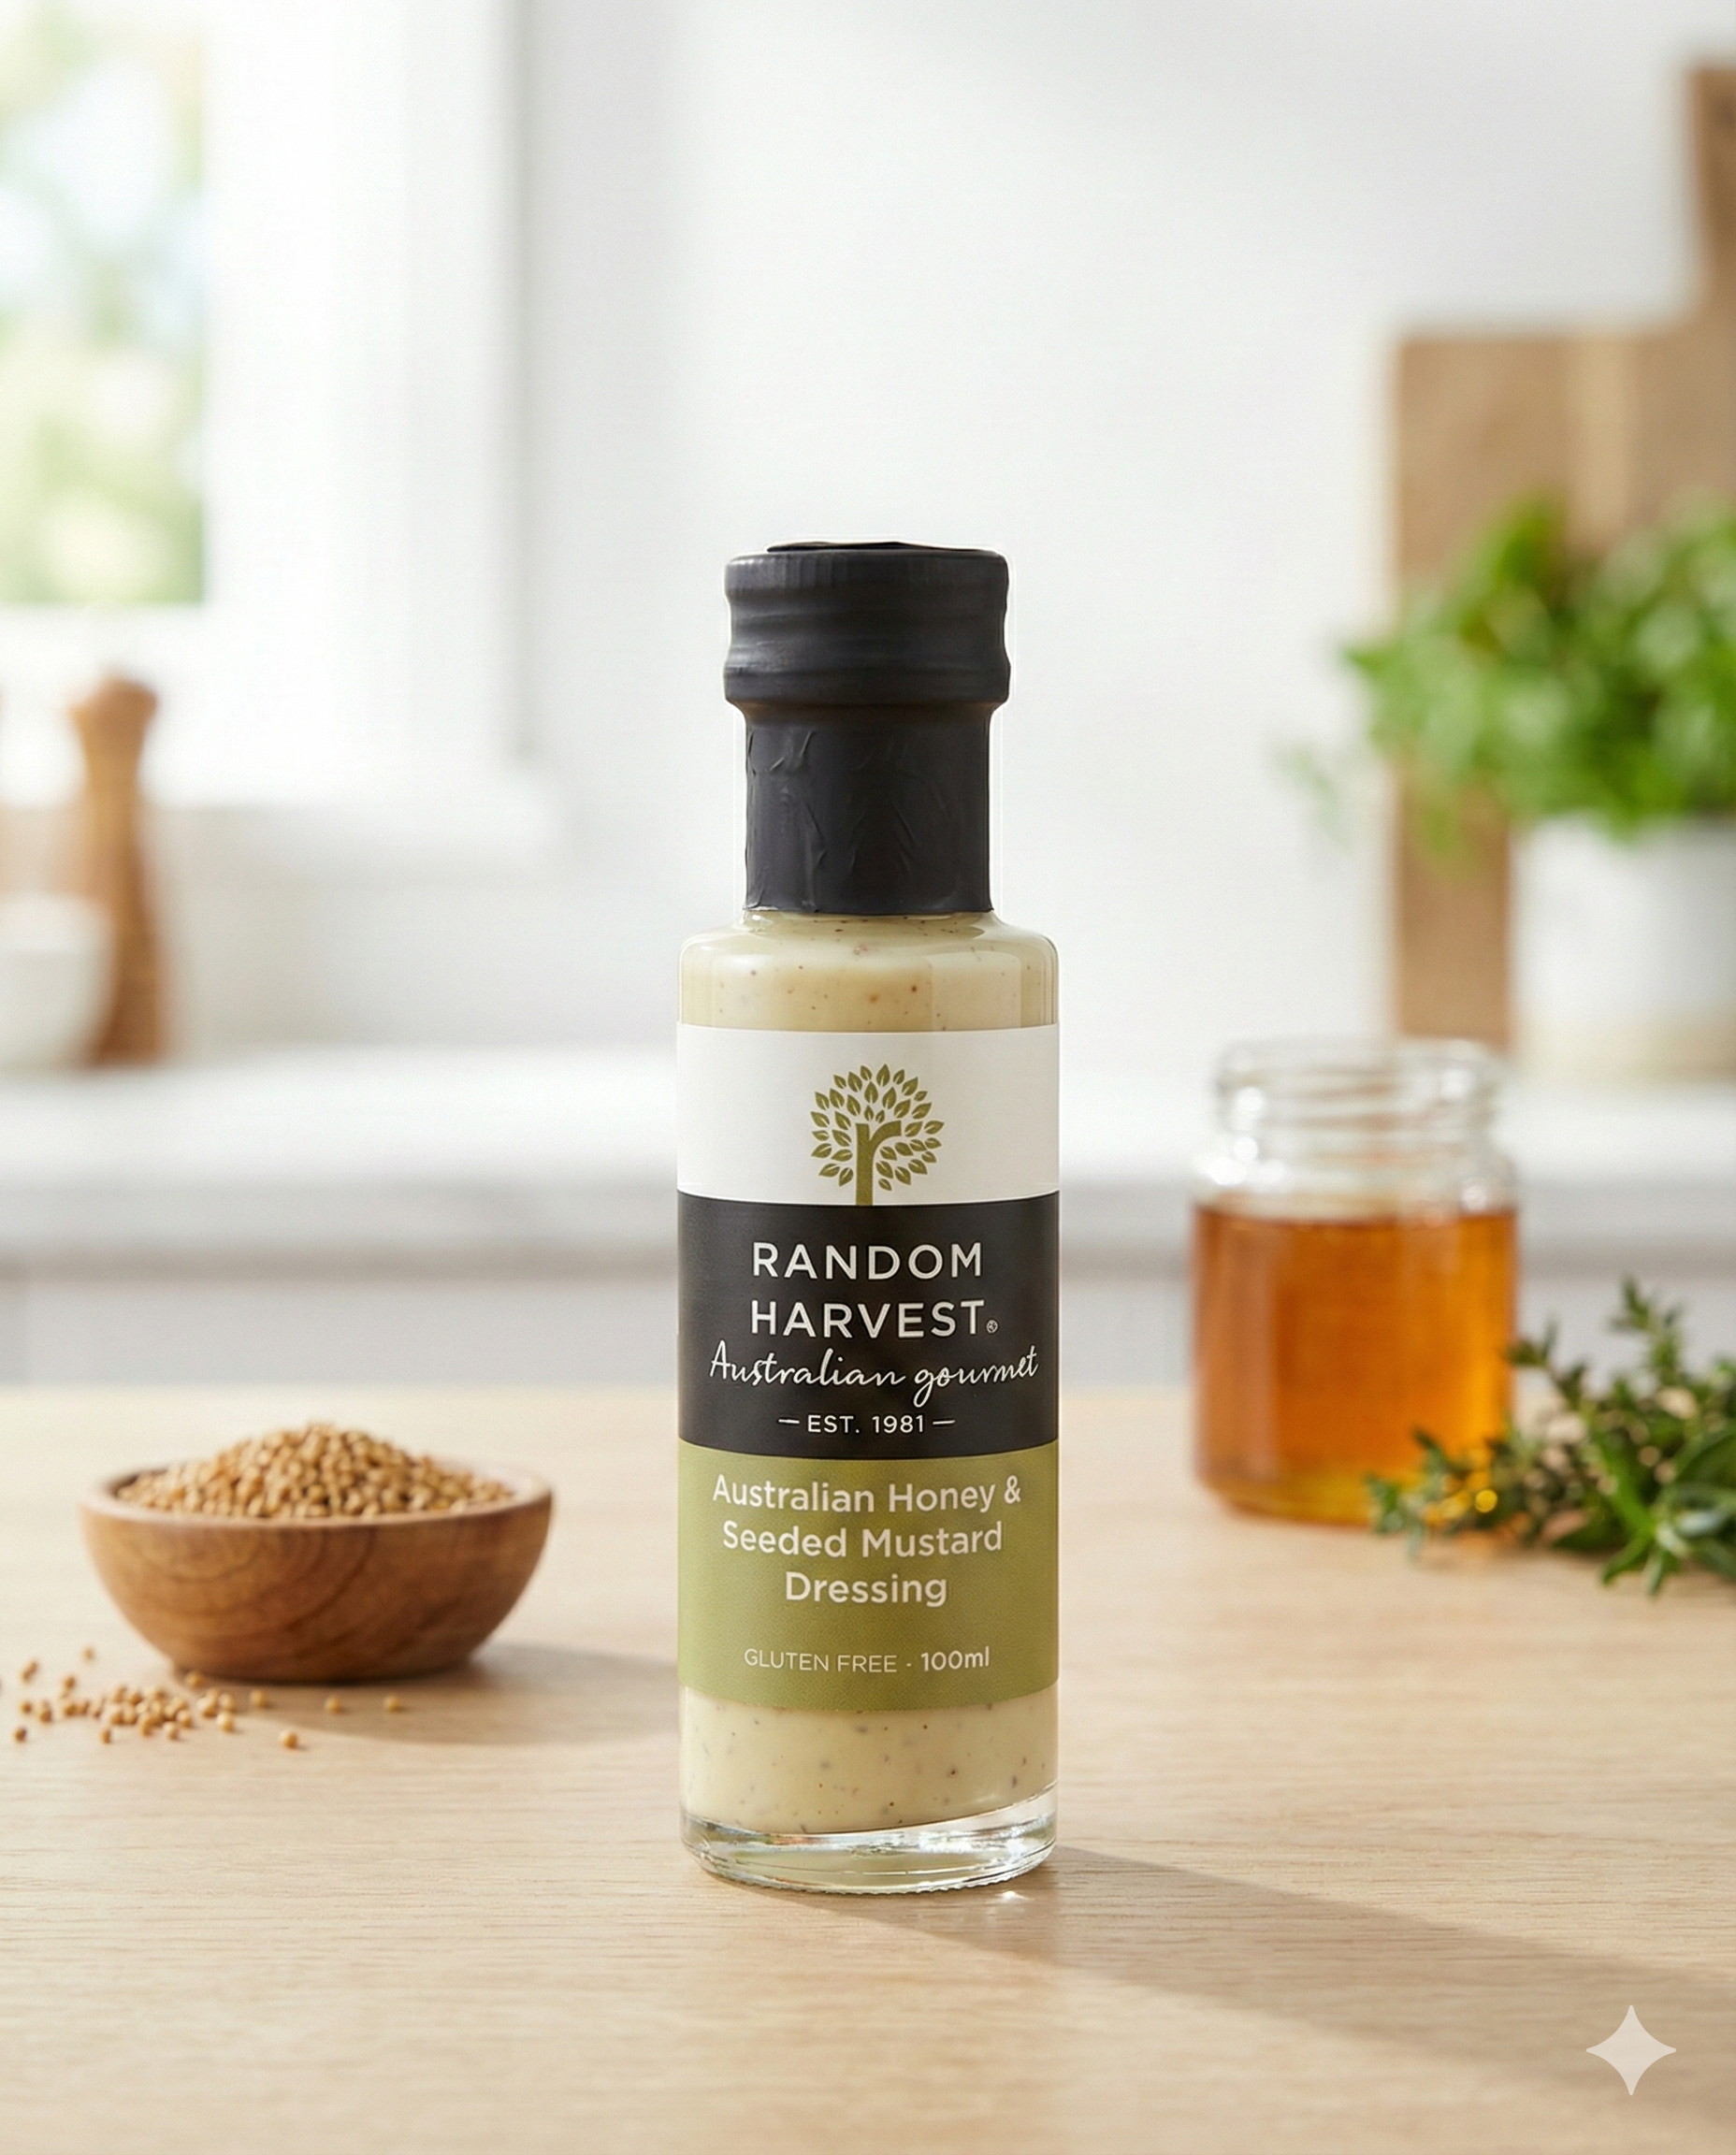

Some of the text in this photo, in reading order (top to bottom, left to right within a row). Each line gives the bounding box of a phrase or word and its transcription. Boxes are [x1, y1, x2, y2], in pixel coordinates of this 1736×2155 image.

[752, 1241, 982, 1280] RANDOM
[709, 1339, 1039, 1408] Australian gourmet
[807, 1414, 924, 1434] EST. 1981
[713, 1474, 1021, 1513] Australian Honey &
[723, 1520, 1003, 1558] Seeded Mustard
[785, 1571, 948, 1608] Dressing
[744, 1645, 991, 1673] GLUTEN FREE 100ml
